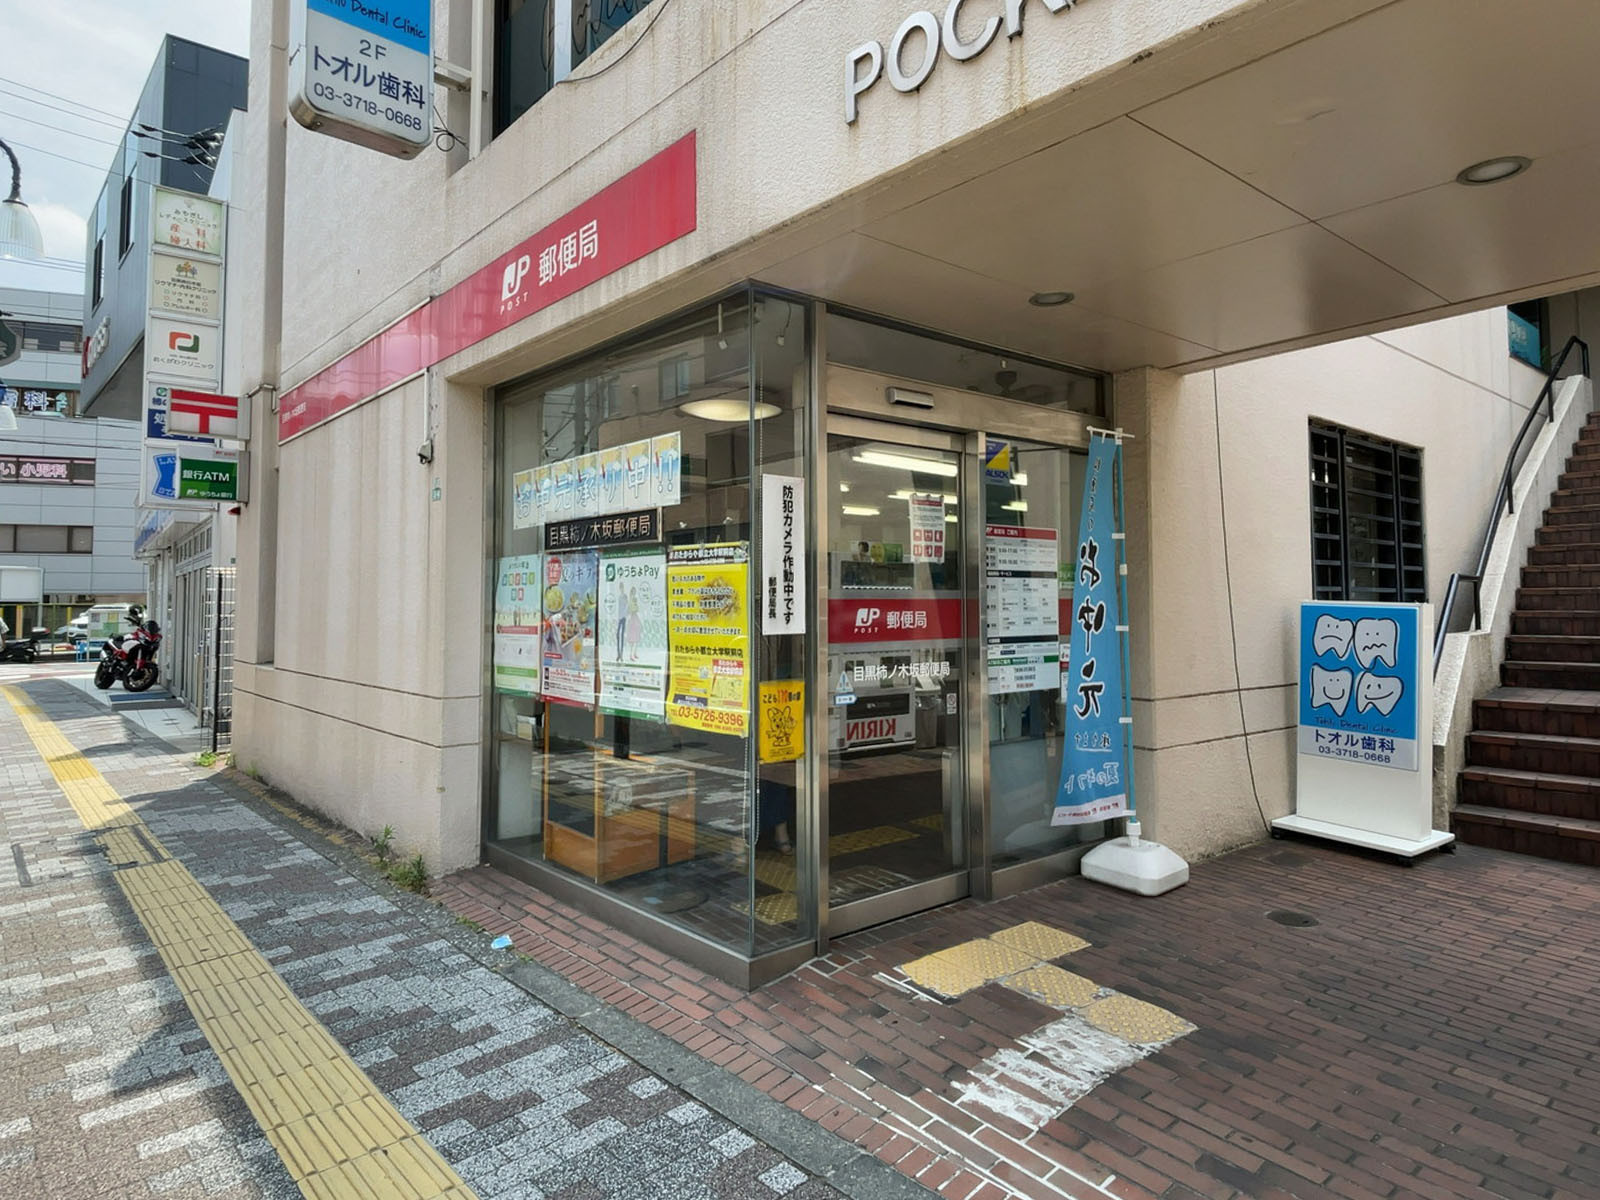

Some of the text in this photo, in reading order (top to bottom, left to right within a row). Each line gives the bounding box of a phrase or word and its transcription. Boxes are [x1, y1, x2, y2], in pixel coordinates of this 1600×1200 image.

[351, 0, 426, 39] Dental Clinic
[359, 39, 387, 60] 2F
[314, 45, 426, 110] トオル歯科
[313, 82, 422, 131] 03-3718-0668
[538, 219, 599, 287] 郵便局
[500, 291, 529, 316] POST
[182, 468, 230, 482] 銀行ATM
[550, 514, 651, 546] 目黒柿ノ木坂郵便局
[782, 485, 795, 625] 防犯カメラ作動中です
[616, 563, 660, 580] ゆうちょPay
[886, 610, 928, 630] 郵便局
[853, 660, 950, 682] 目黒柿ノ木坂郵便局
[678, 706, 744, 727] 03-5726-9396
[1314, 729, 1396, 754] トオル歯科
[1318, 746, 1392, 764] 03-3718-0668
